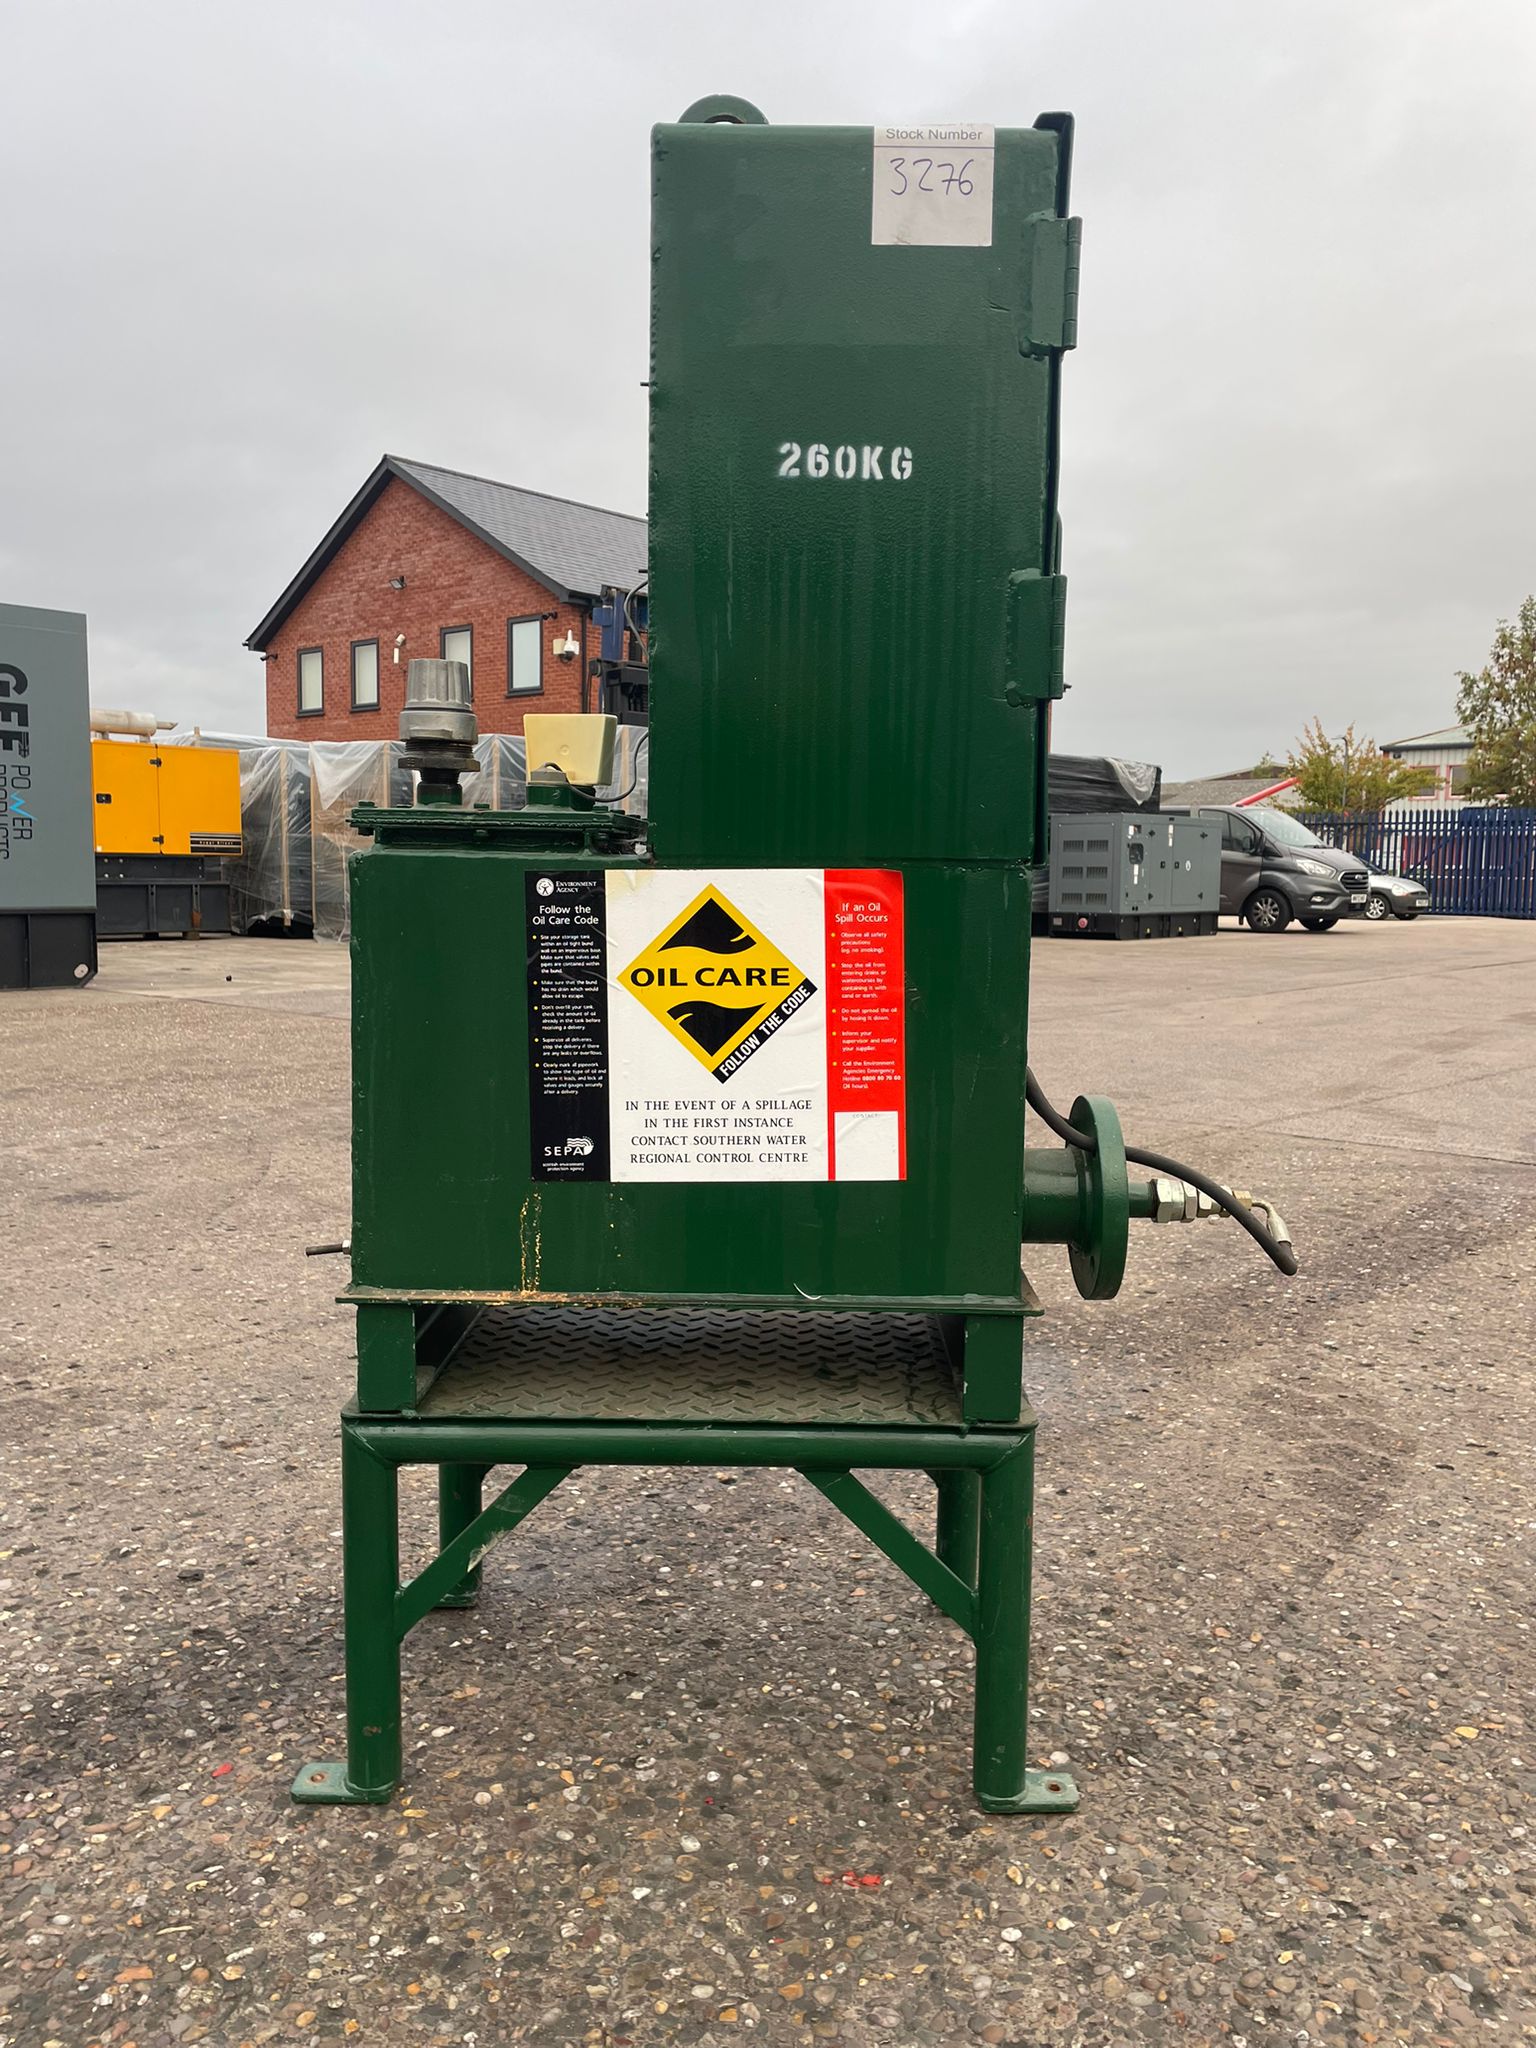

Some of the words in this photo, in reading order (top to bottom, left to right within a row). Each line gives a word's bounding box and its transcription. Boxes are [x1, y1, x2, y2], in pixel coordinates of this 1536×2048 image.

[886, 128, 924, 139] Stock
[928, 129, 983, 140] Number
[890, 158, 974, 195] 3276
[778, 442, 912, 480] 260KG
[11, 765, 36, 840] POWER
[539, 905, 571, 914] Follow
[574, 905, 591, 914] the
[842, 903, 849, 911] If
[853, 903, 864, 911] an
[868, 903, 881, 911] Oil
[532, 916, 546, 925] Oil
[549, 916, 570, 925] Care
[574, 916, 599, 925] Code
[835, 914, 853, 924] Spill
[856, 914, 888, 923] Occurs
[630, 968, 688, 987] OIL
[694, 968, 790, 987] CARE
[718, 1034, 761, 1077] FOLLOW
[758, 1012, 784, 1036] THE
[780, 985, 810, 1014] CODE
[625, 1100, 639, 1110] IN
[644, 1100, 669, 1110] THE
[674, 1100, 716, 1110] EVENT
[720, 1100, 737, 1110] OF
[742, 1100, 750, 1110] A
[755, 1100, 812, 1110] SPILLAGE
[644, 1118, 658, 1128] IN
[663, 1118, 688, 1128] THE
[694, 1118, 729, 1128] FIRST
[734, 1118, 793, 1128] INSTANCE
[631, 1135, 688, 1145] CONTACT
[693, 1135, 761, 1145] SOUTHERN
[766, 1135, 807, 1145] WATER
[544, 1146, 584, 1156] SEPA
[630, 1153, 691, 1163] REGIONAL
[696, 1153, 754, 1163] CONTROL
[759, 1153, 808, 1163] CENTRE
